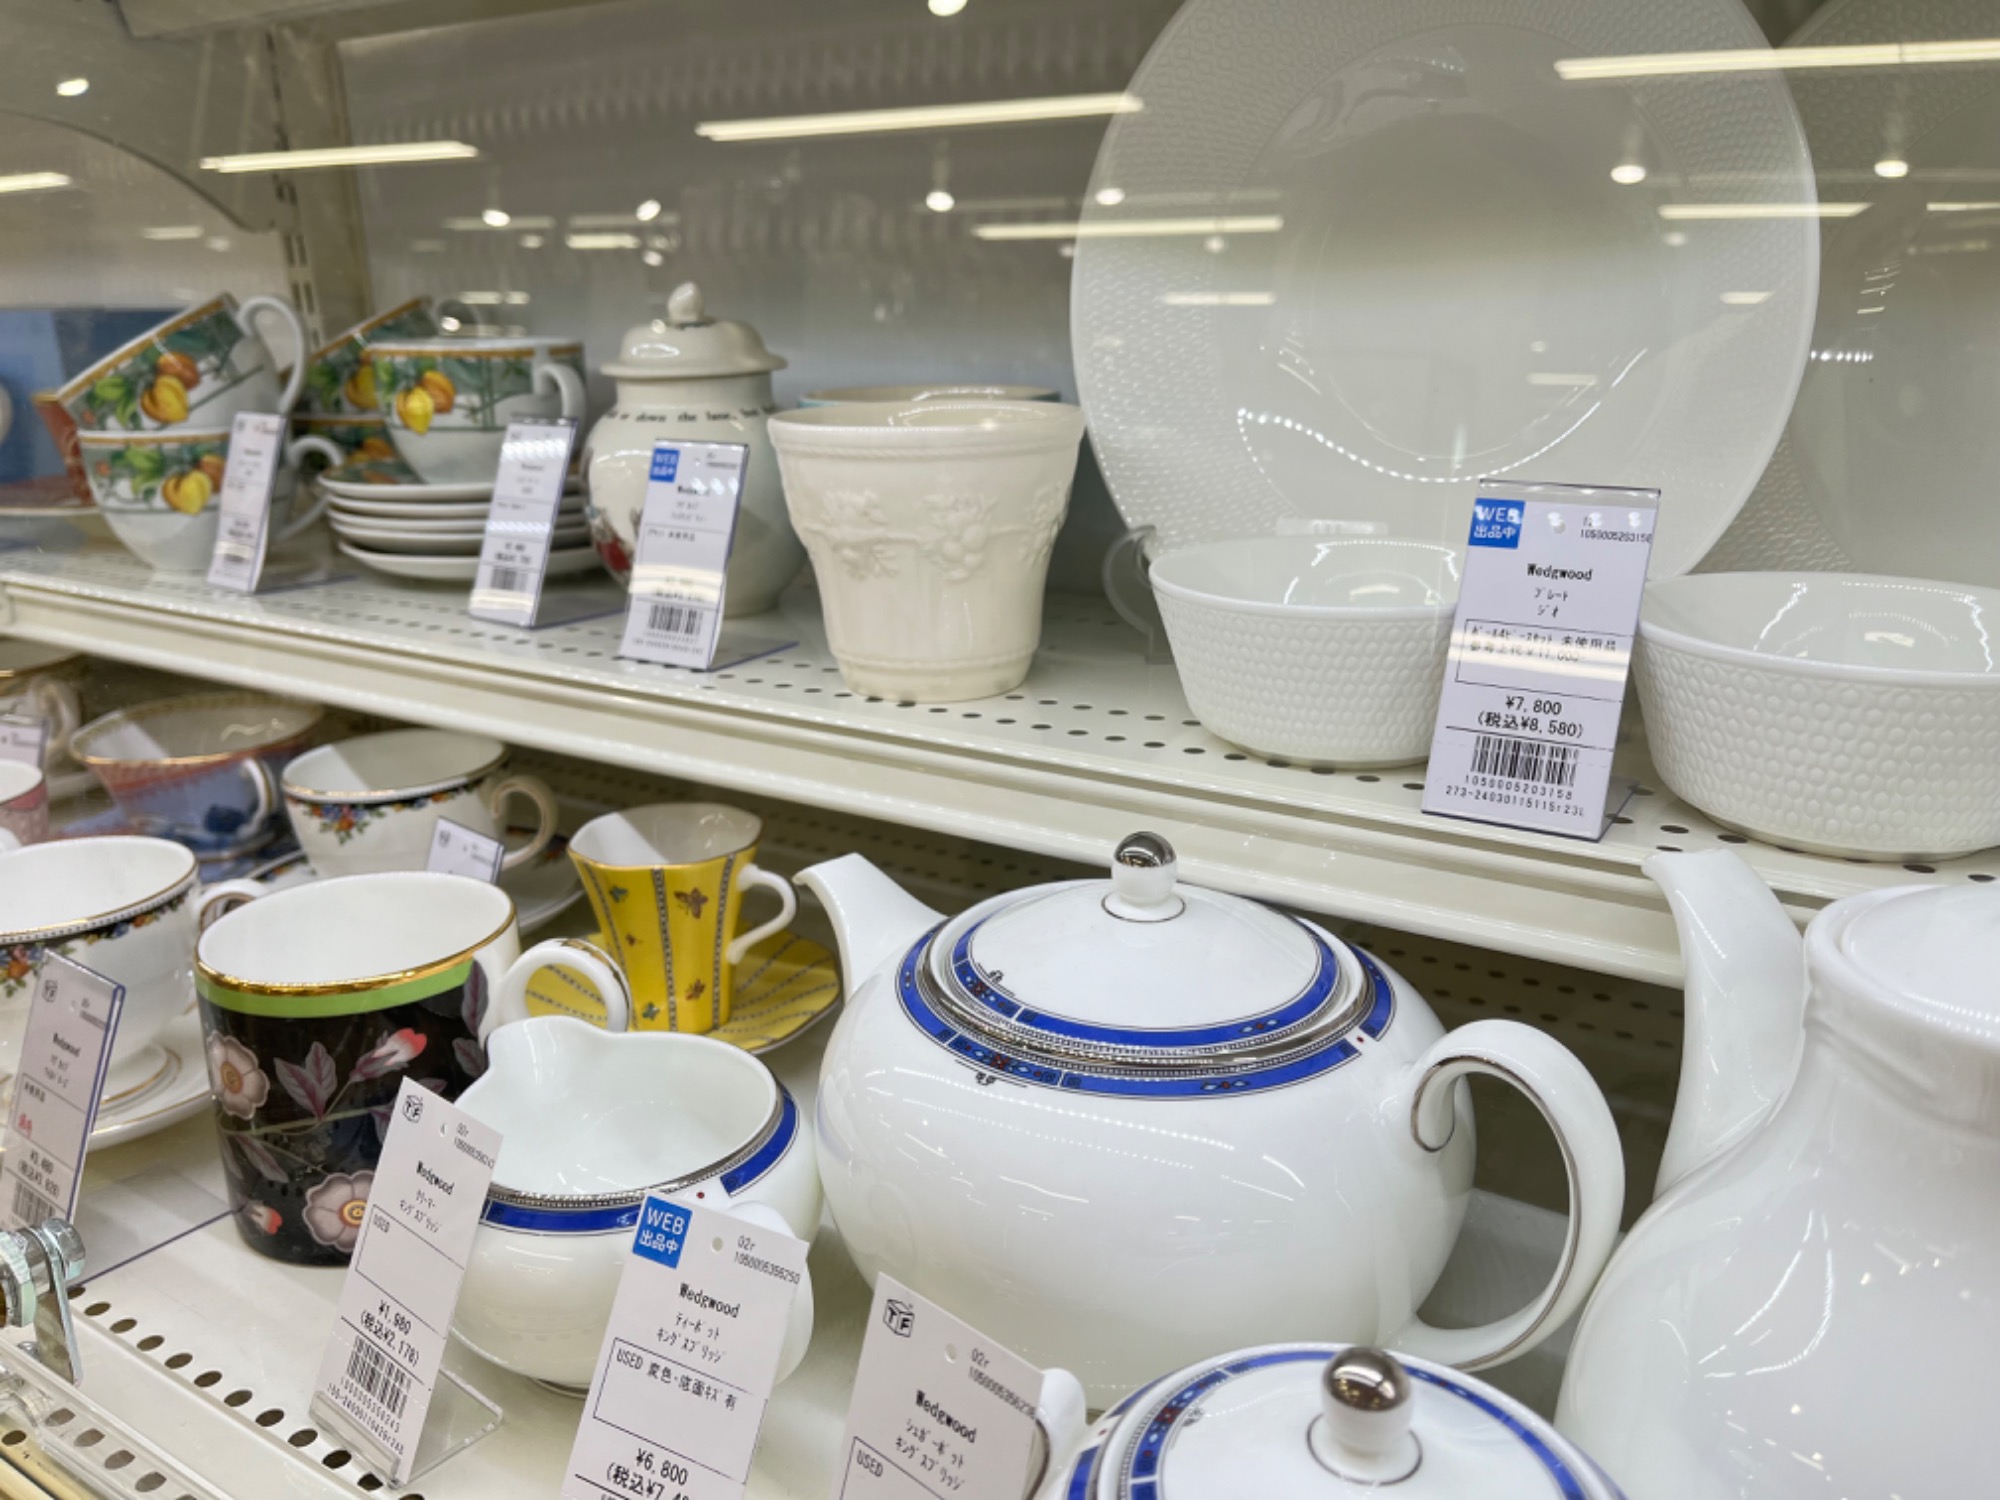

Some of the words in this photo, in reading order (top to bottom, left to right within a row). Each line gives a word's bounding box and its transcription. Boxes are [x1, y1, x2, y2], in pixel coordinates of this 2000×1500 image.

[1474, 505, 1521, 525] WEB
[1473, 525, 1517, 541] 出品中
[1526, 563, 1593, 581] Wedgwood
[1560, 634, 1617, 652] 未使用品
[415, 1159, 456, 1196] Wedgwood
[646, 1206, 685, 1236] WEB
[639, 1228, 679, 1256] 出品中
[679, 1281, 742, 1320] Wedgwood
[616, 1347, 644, 1371] USED
[916, 1388, 977, 1445] Wedgwood
[856, 1448, 884, 1479] USED
